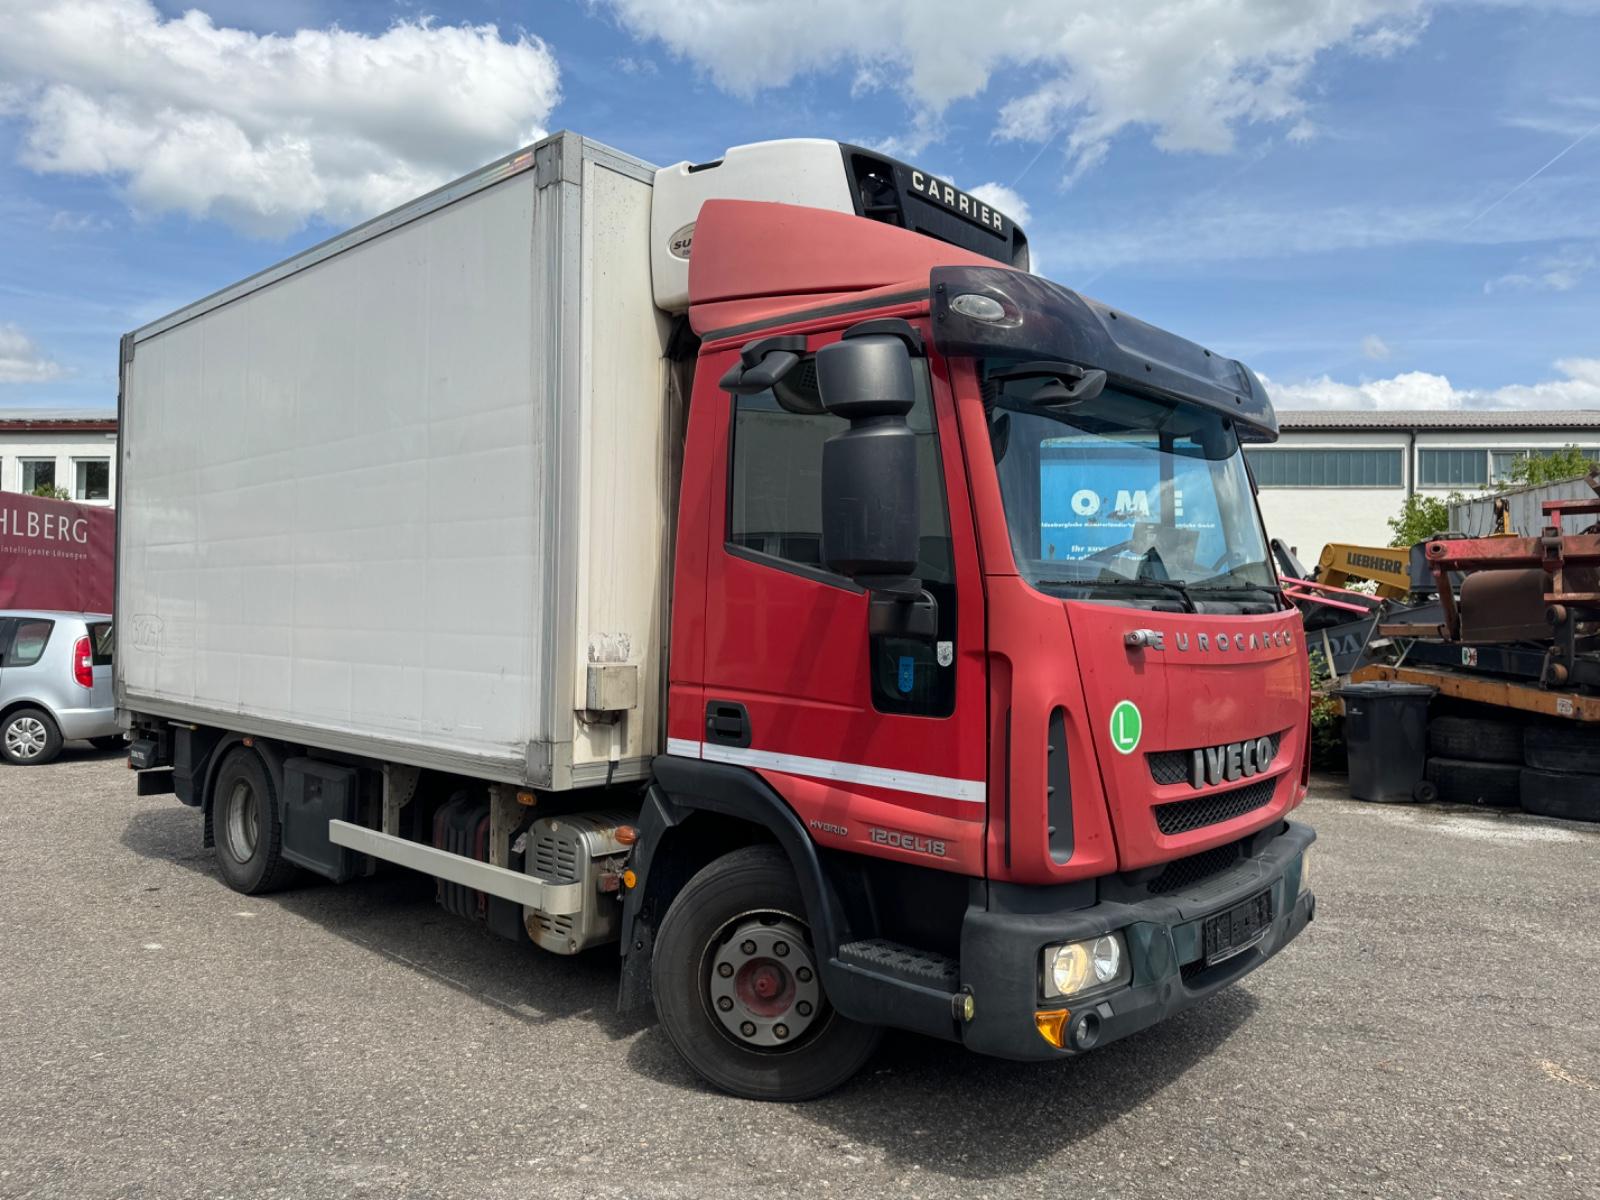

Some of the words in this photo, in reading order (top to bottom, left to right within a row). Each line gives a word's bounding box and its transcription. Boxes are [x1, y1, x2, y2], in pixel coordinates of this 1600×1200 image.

[912, 171, 1002, 230] CARRIER
[1347, 552, 1403, 575] LIEBHERR
[1152, 630, 1291, 651] EUROCARGO
[1119, 711, 1134, 744] L
[1193, 737, 1273, 789] IVECO
[810, 819, 848, 836] HYBRID
[868, 827, 945, 856] 120EL18
